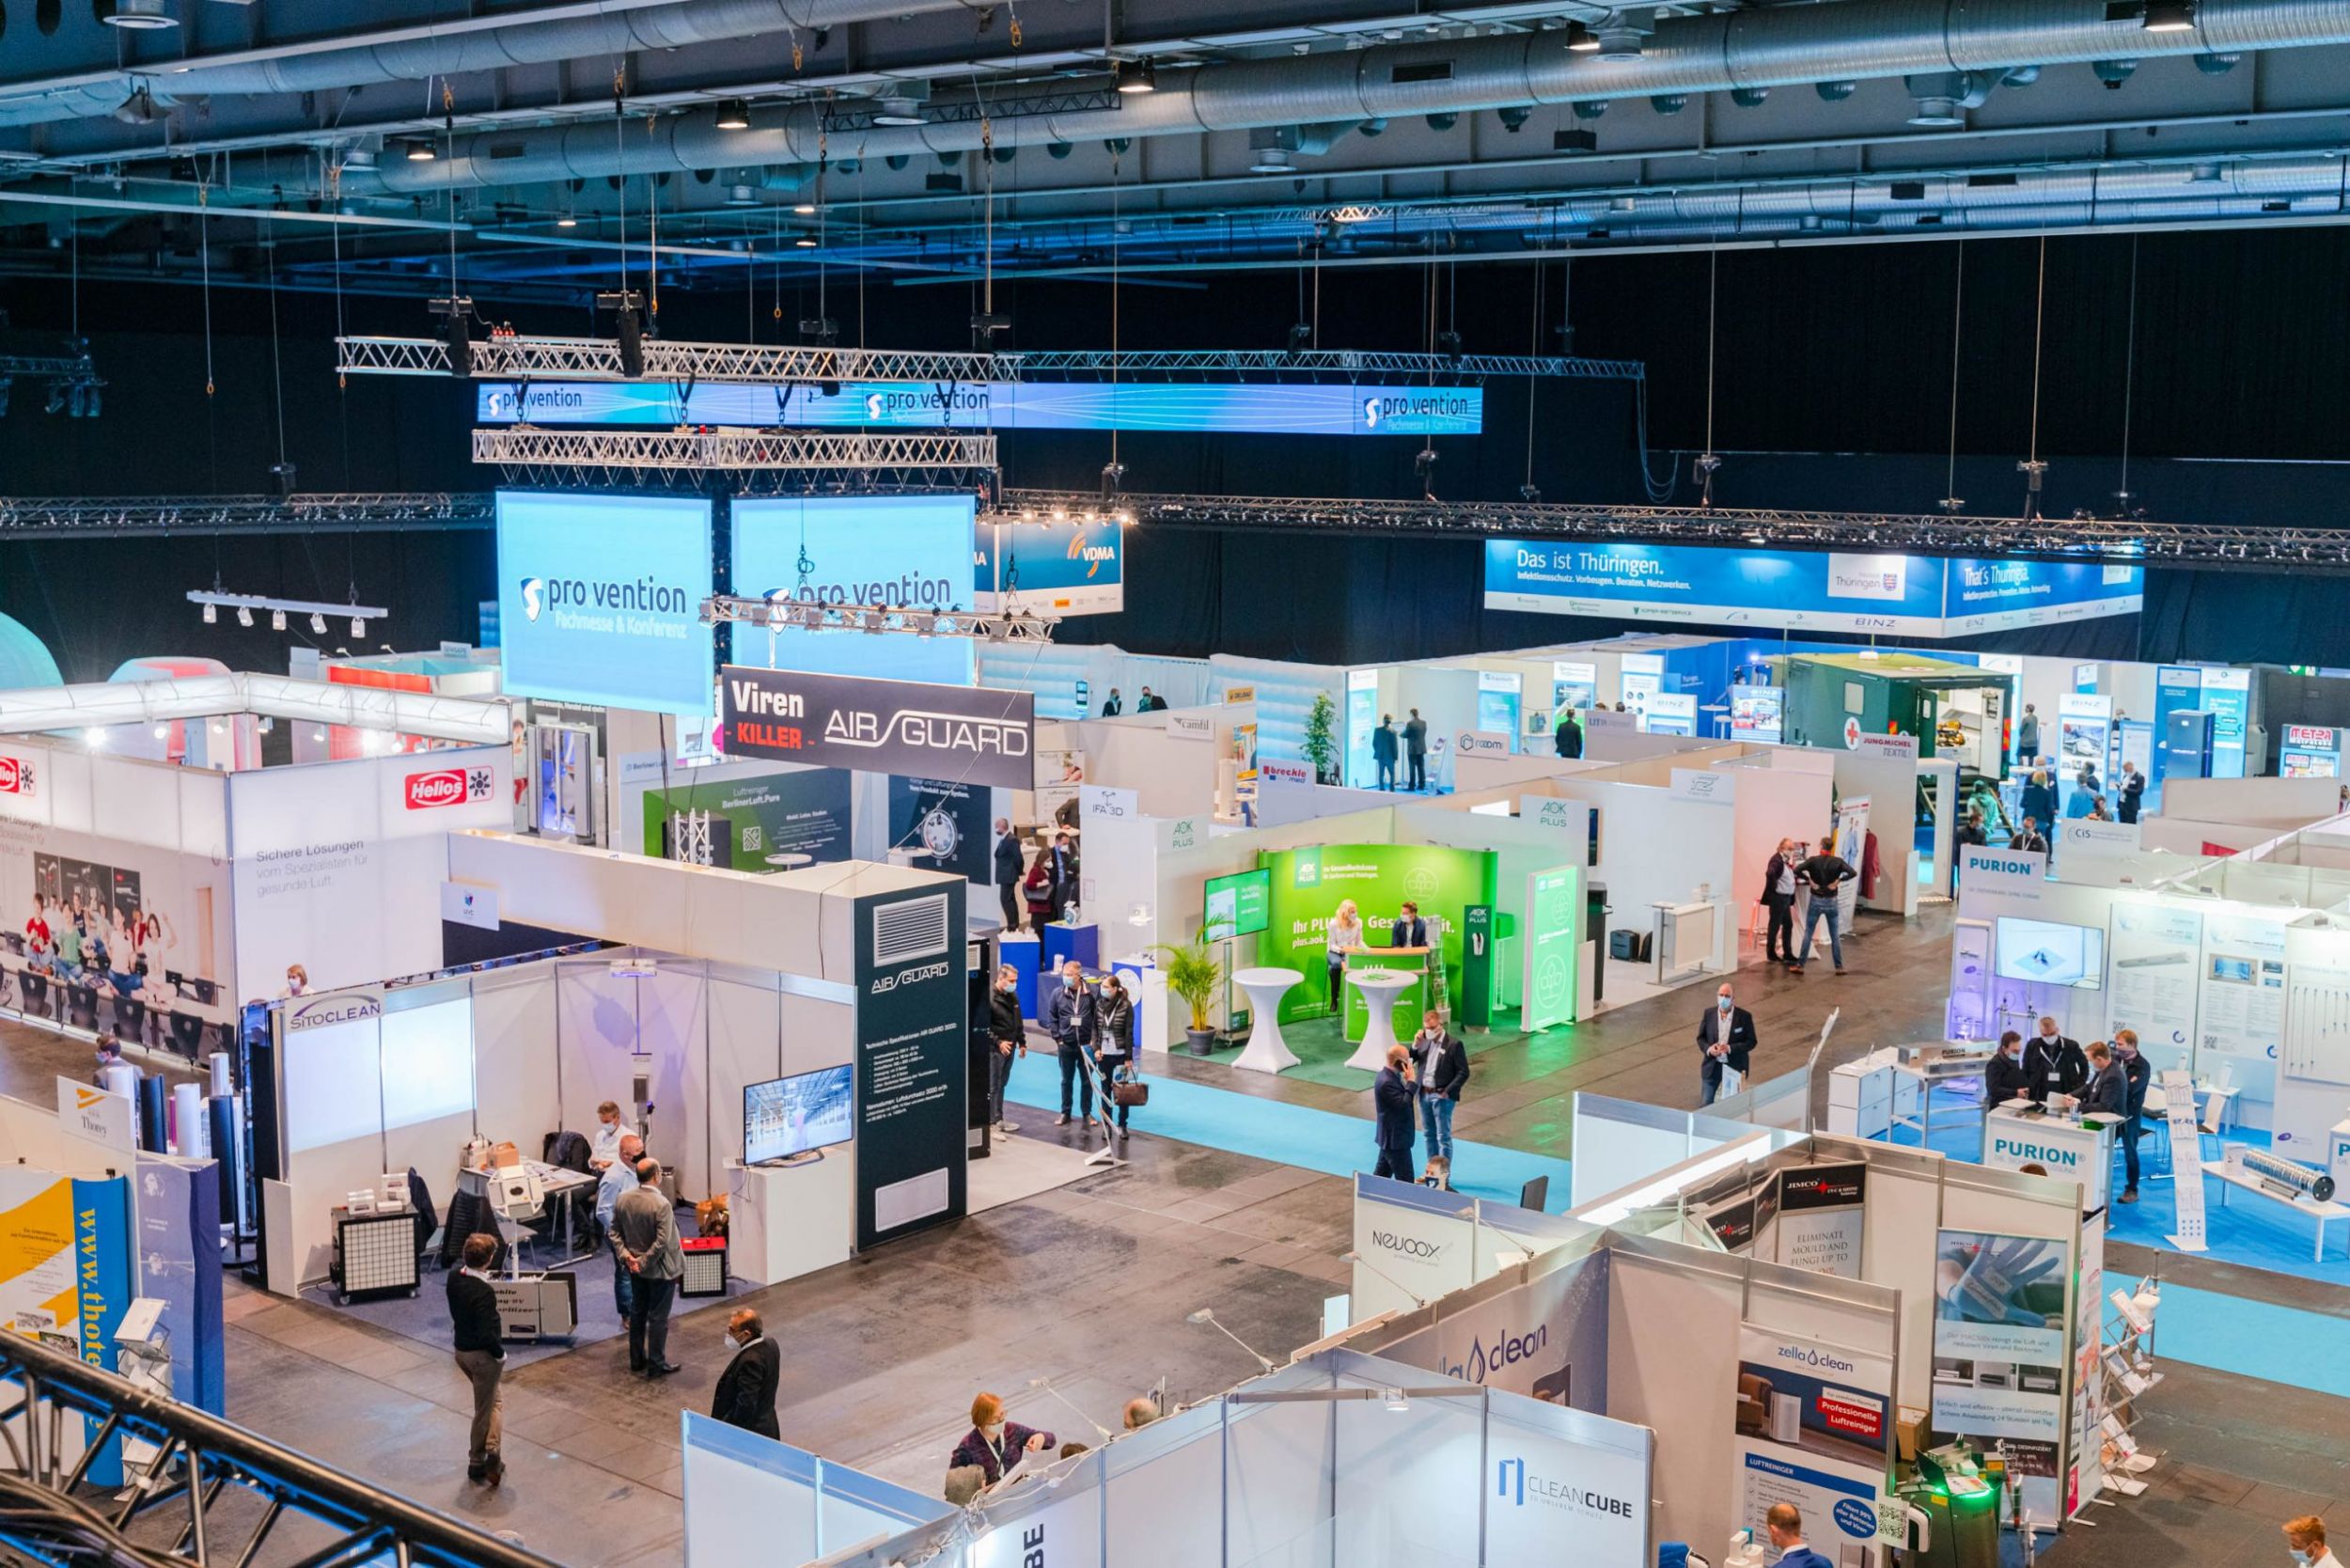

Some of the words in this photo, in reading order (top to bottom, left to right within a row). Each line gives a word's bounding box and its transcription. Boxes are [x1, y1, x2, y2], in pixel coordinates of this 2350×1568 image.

[887, 393, 916, 413] pro
[1384, 397, 1408, 419] pro
[1412, 391, 1467, 415] vention
[1083, 546, 1116, 561] VDMA
[1517, 549, 1546, 569] Das
[1553, 551, 1572, 570] ist
[1579, 553, 1665, 577] Thüringen.
[548, 579, 587, 611] pro
[592, 575, 687, 614] vention
[853, 570, 951, 605] vention
[1855, 618, 1897, 628] BINZ
[731, 680, 805, 718] Viren
[825, 709, 877, 743] AIR
[901, 715, 1028, 757] GUARD
[1181, 720, 1210, 731] camfil
[737, 722, 803, 750] KILLER
[1863, 738, 1911, 748] JUNGMICHEL
[1270, 767, 1307, 778] breckle
[1288, 776, 1307, 785] med
[411, 780, 463, 800] Helios
[1092, 804, 1107, 815] IFA
[1110, 807, 1124, 817] 3D
[1542, 801, 1568, 816] AOK
[1172, 820, 1194, 836] AOK
[1540, 816, 1567, 827] PLUS
[2075, 828, 2091, 839] CiS
[256, 848, 303, 863] Sichere
[306, 839, 365, 856] Lösungen
[1172, 837, 1195, 849] PLUS
[1969, 856, 2031, 876] PURION
[1468, 908, 1487, 917] AOK
[1293, 918, 1308, 934] Ihr
[1311, 917, 1331, 933] PLU
[870, 976, 894, 994] AIR
[901, 963, 949, 985] GUARD
[1786, 1180, 1819, 1190] JIMCO
[1796, 1230, 1844, 1243] ELIMINATE
[1792, 1246, 1827, 1256] MOULD
[1828, 1241, 1849, 1252] AND
[1790, 1256, 1820, 1267] FUNGI
[1822, 1255, 1833, 1264] UP
[1836, 1252, 1849, 1262] TO
[1489, 1323, 1547, 1372] clean
[1778, 1346, 1806, 1360] zella
[1820, 1354, 1855, 1373] clean
[1821, 1401, 1878, 1423] Professionelle
[1830, 1415, 1878, 1435] Luftreiniger
[1748, 1458, 1794, 1475] LUFTREINIGER
